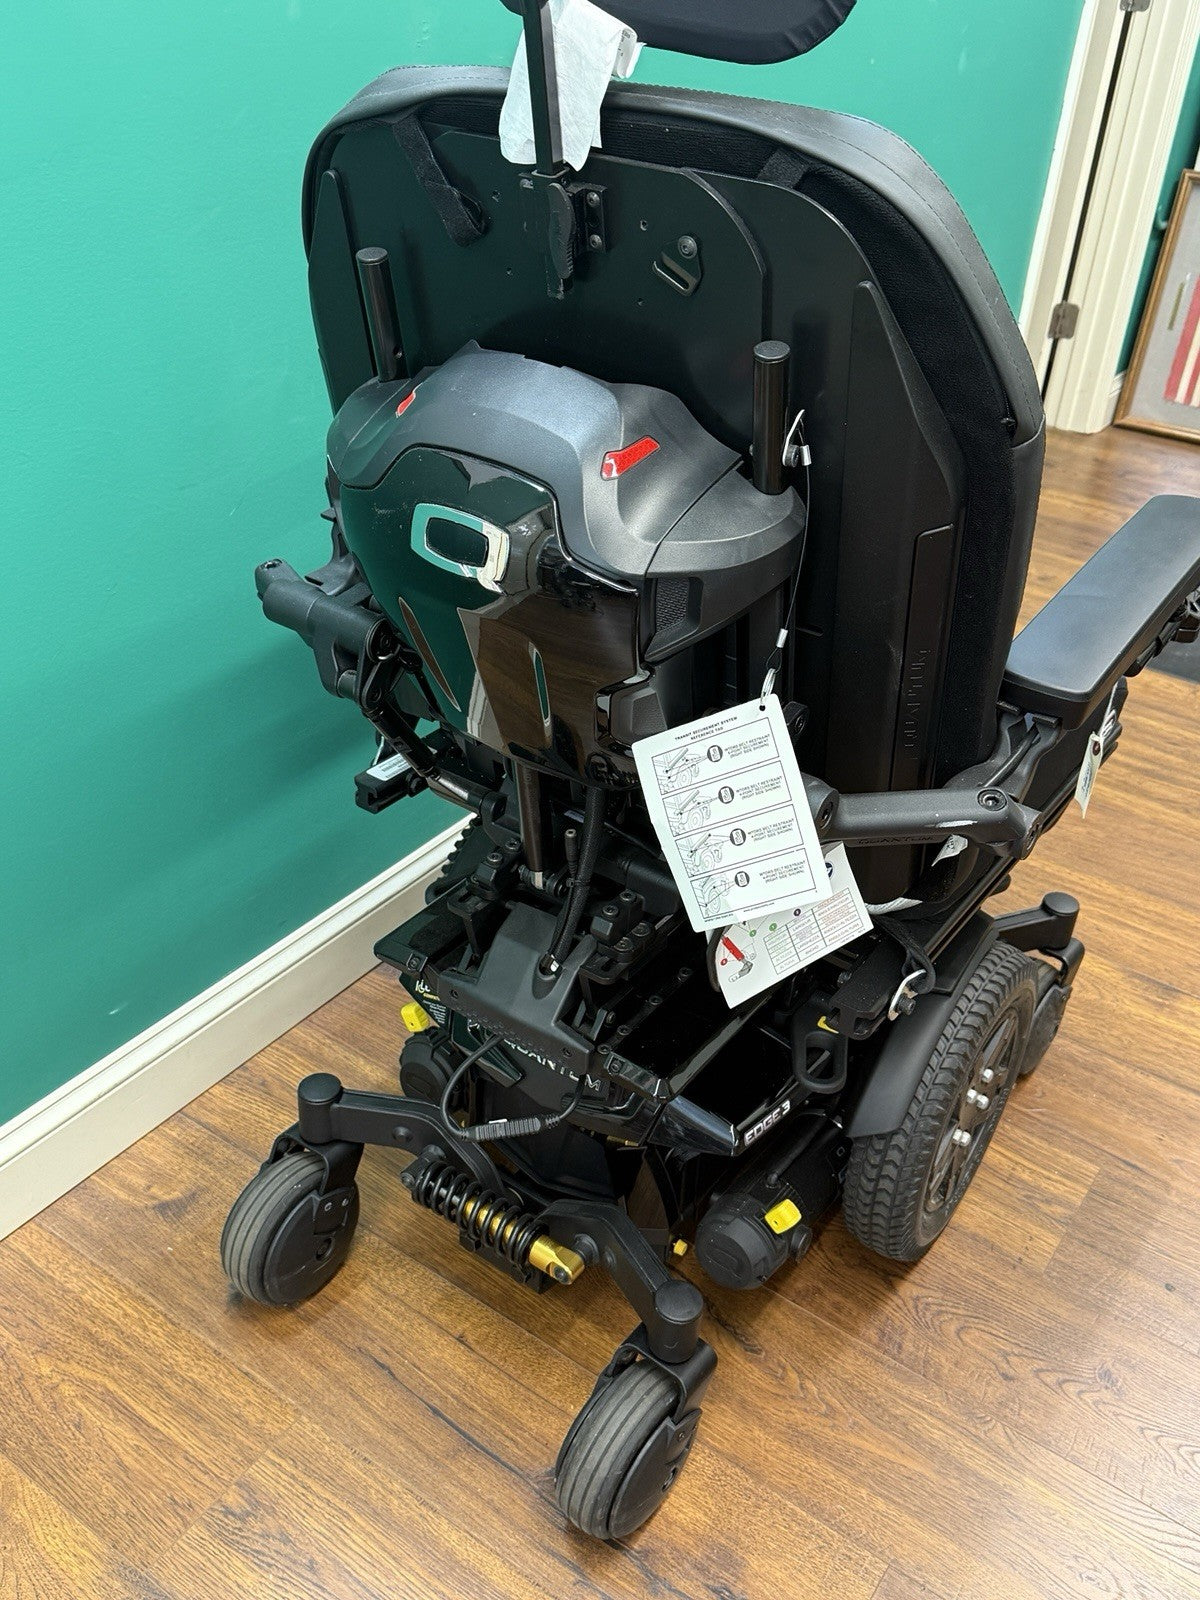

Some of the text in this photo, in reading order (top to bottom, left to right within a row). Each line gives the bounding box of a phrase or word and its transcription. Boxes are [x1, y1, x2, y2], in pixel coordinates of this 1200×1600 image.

[675, 716, 737, 740] TRANSIT SECUREMENT SYSTEM
[691, 730, 714, 740] REFERENCE
[744, 1099, 791, 1147] EDGE 3
